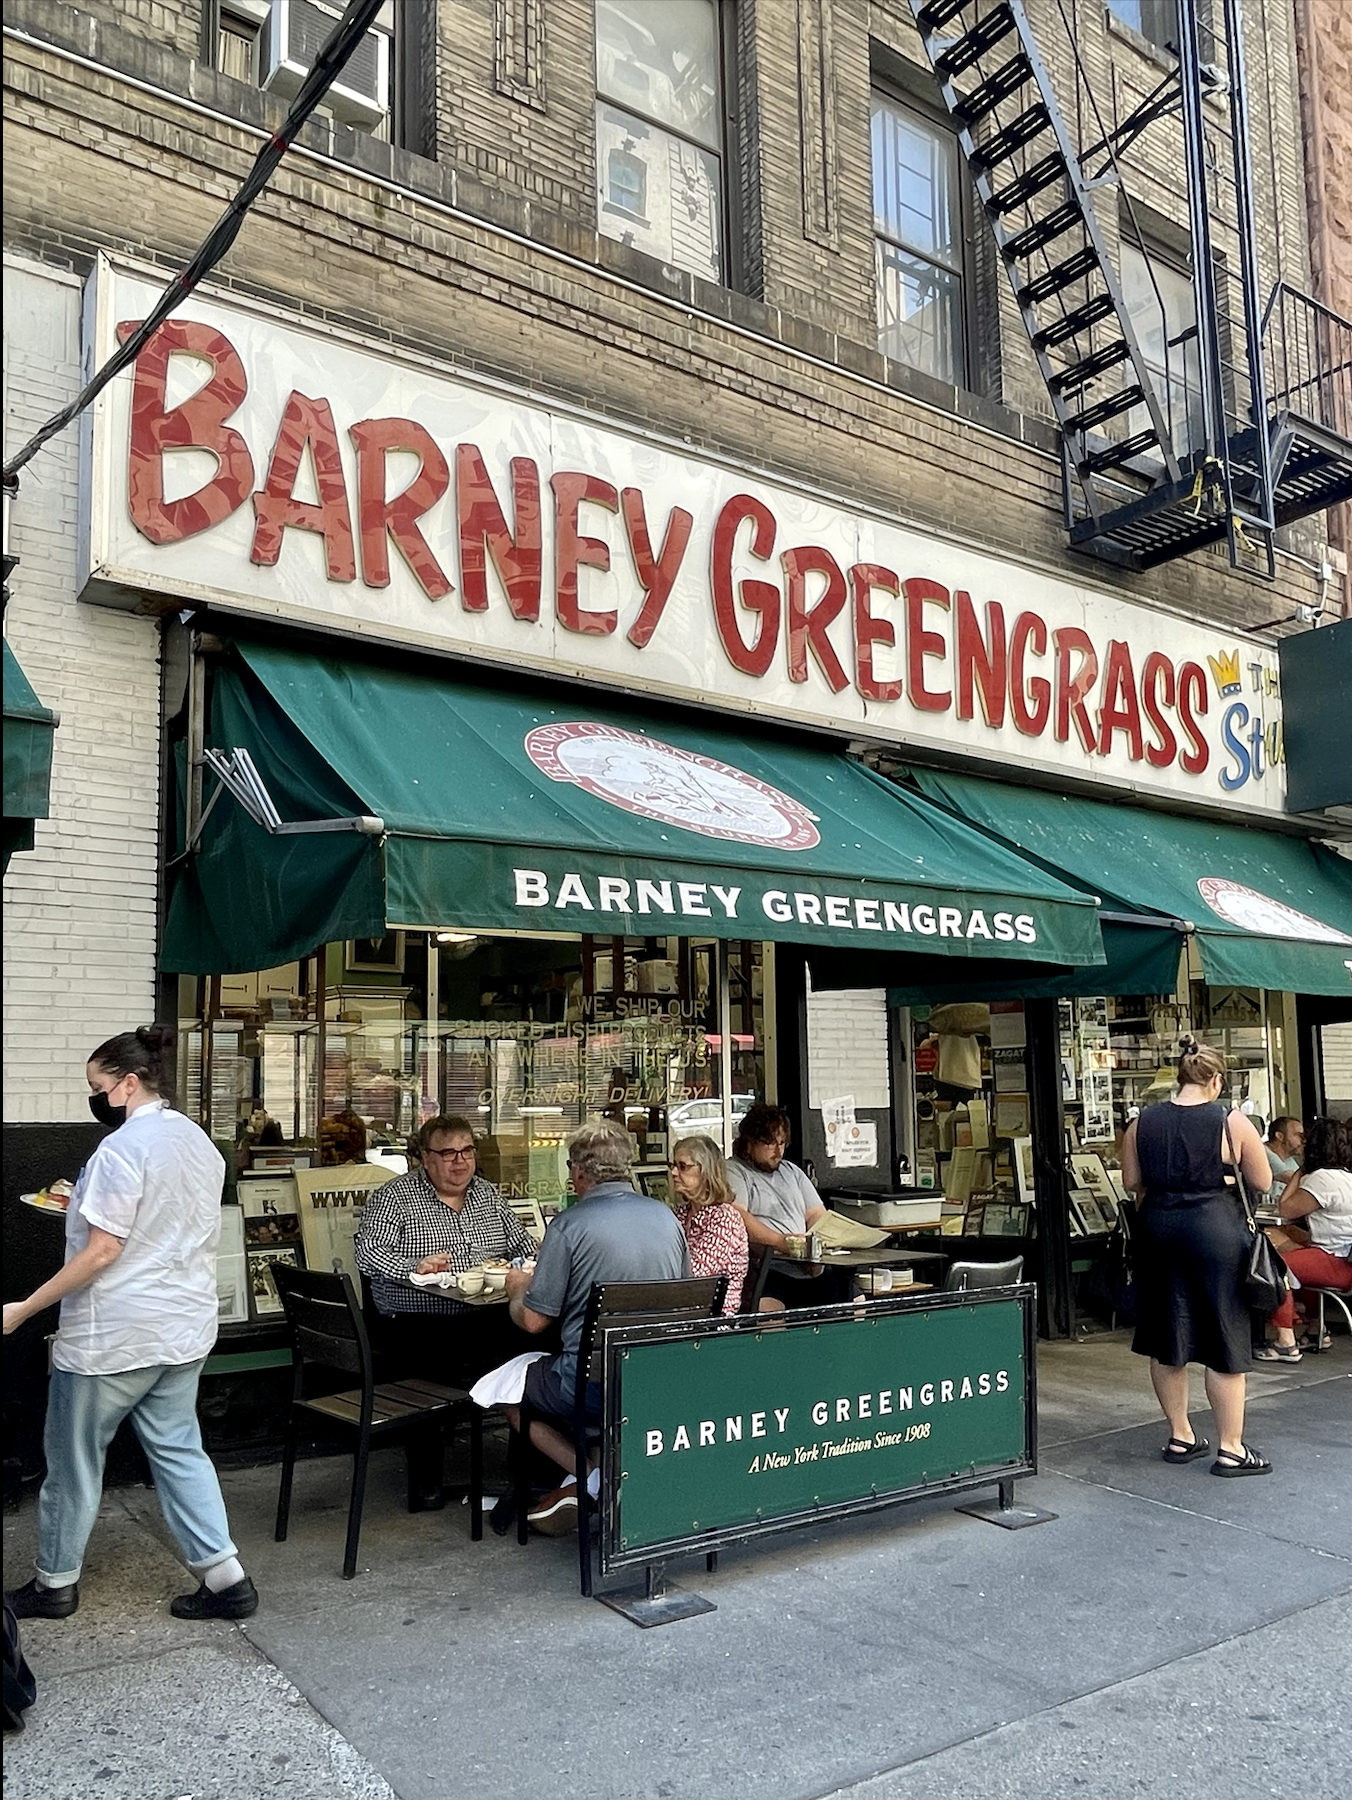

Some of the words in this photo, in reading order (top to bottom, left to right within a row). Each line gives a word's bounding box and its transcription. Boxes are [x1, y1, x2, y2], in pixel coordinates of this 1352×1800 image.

[116, 319, 694, 650] BARNEY
[710, 494, 1208, 774] GREENGRASS
[632, 804, 676, 823] THE
[513, 868, 742, 919] BARNEY
[761, 890, 1037, 945] GREENGRASS
[577, 995, 606, 1015] WE
[615, 997, 659, 1017] SHIP
[668, 999, 707, 1019] OUR
[455, 1019, 545, 1040] SMOKED
[994, 1049, 1026, 1059] ZAGAT
[646, 1408, 790, 1457] BARNEY
[812, 1370, 1010, 1426] GREENGRASS
[748, 1455, 760, 1474] A
[762, 1452, 791, 1471] New
[794, 1443, 818, 1464] York
[821, 1437, 871, 1459] Tradition
[873, 1431, 902, 1449] Since
[904, 1422, 931, 1442] 1908
